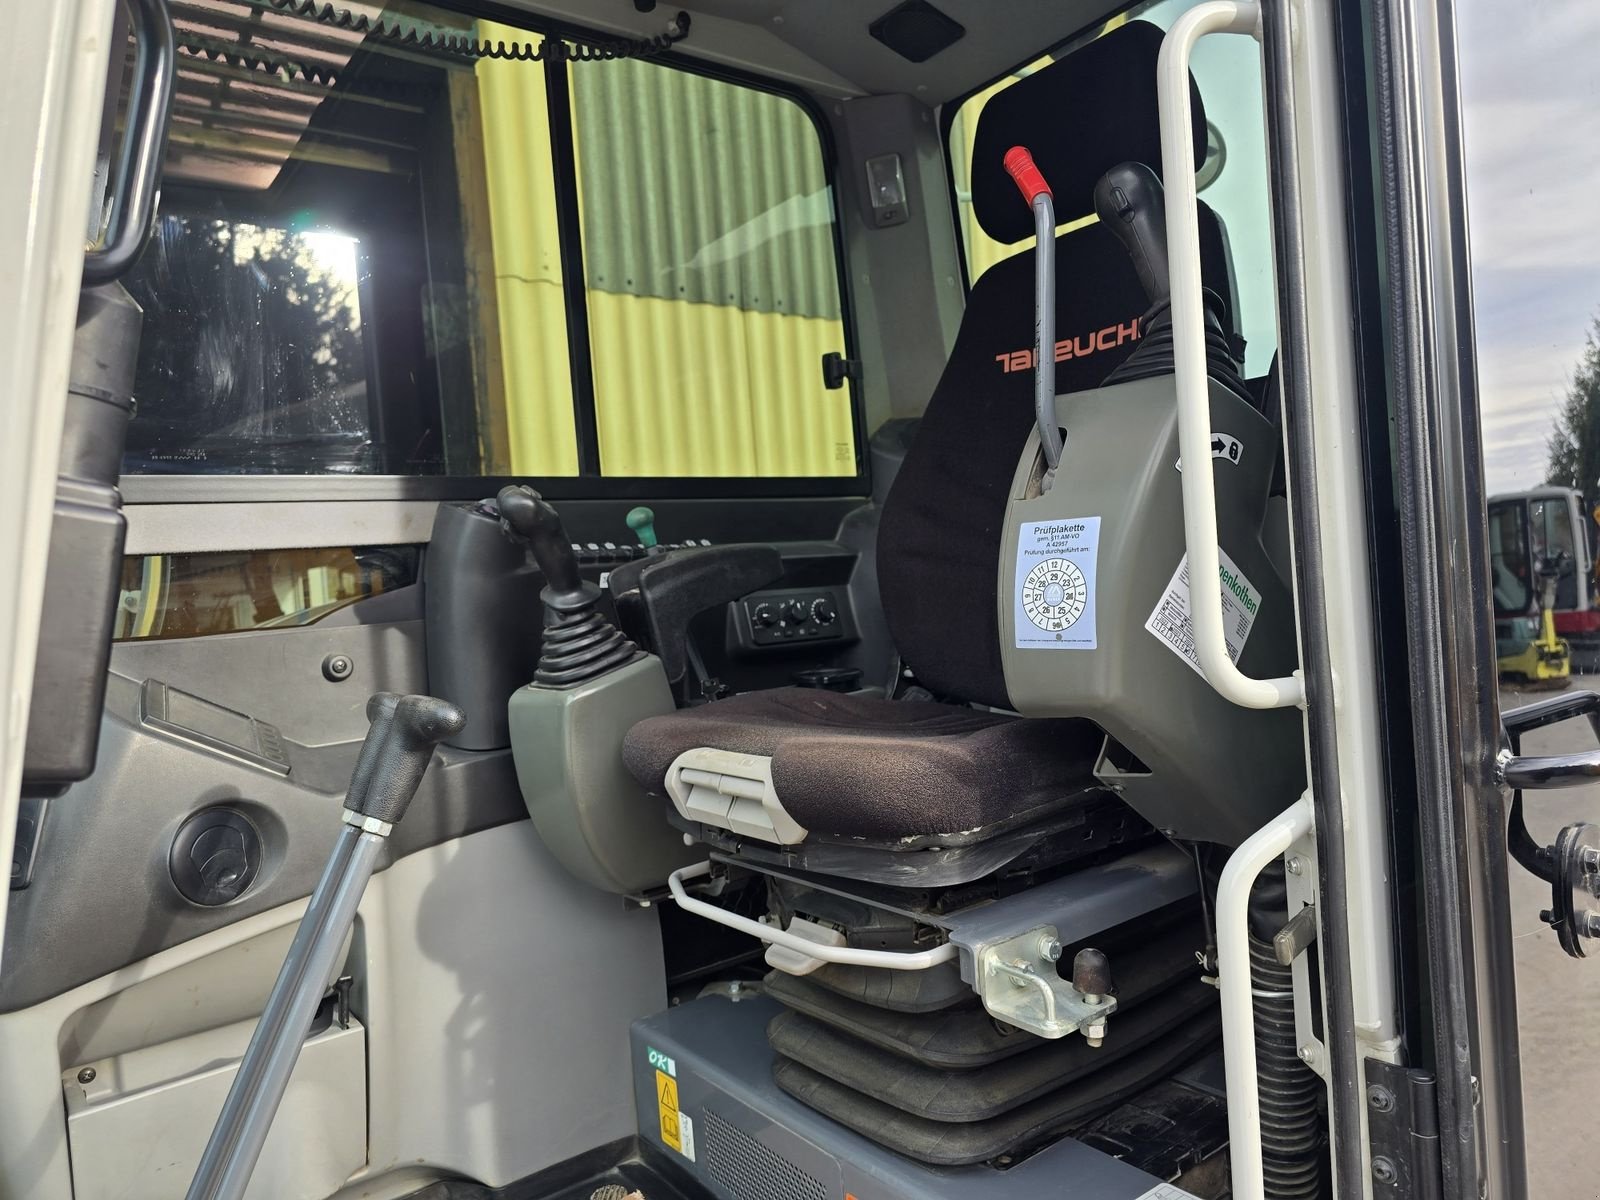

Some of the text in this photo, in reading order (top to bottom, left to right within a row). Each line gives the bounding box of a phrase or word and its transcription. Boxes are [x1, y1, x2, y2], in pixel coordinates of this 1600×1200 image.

[995, 316, 1144, 373] TAEUCH
[1034, 524, 1085, 535] Prüfplakette
[1045, 547, 1079, 555] durchgeführt
[1051, 561, 1058, 569] 12
[1037, 566, 1045, 574] 11
[1028, 577, 1036, 585] 10
[1050, 573, 1058, 581] 29
[1038, 580, 1046, 588] 28
[1062, 579, 1070, 587] 23
[1034, 593, 1042, 601] 27
[1042, 606, 1050, 614] 26
[1058, 606, 1066, 615] 25
[648, 1050, 667, 1070] OK
